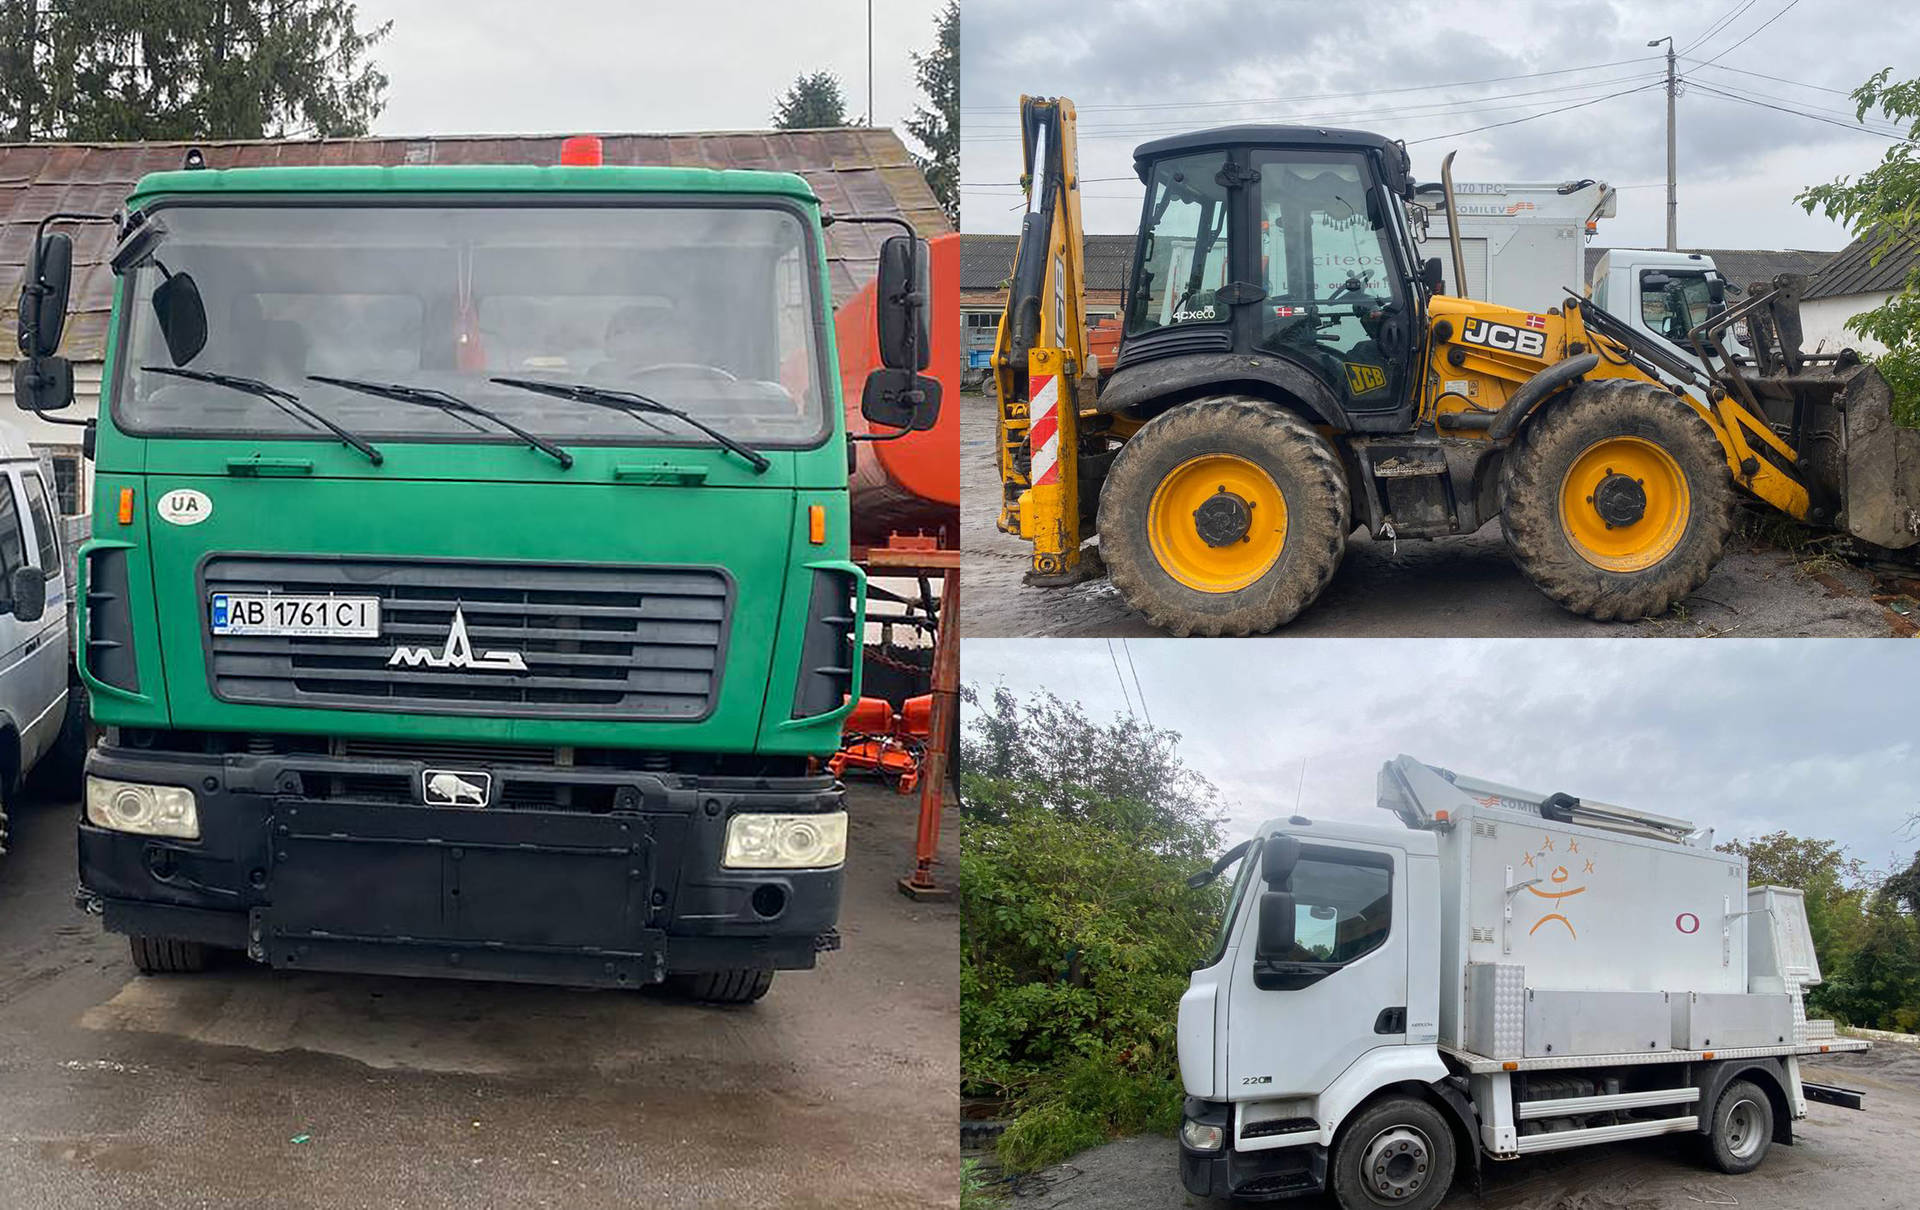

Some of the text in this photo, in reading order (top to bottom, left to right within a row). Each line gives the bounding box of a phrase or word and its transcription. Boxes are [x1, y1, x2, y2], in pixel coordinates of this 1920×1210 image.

[1457, 183, 1502, 193] 170 TPC
[1313, 253, 1384, 266] citeos
[1463, 321, 1545, 356] JCB
[1350, 365, 1385, 393] JCB
[172, 497, 199, 511] UA
[230, 601, 265, 625] AB
[274, 602, 328, 626] 1761
[1500, 798, 1539, 814] COMIL
